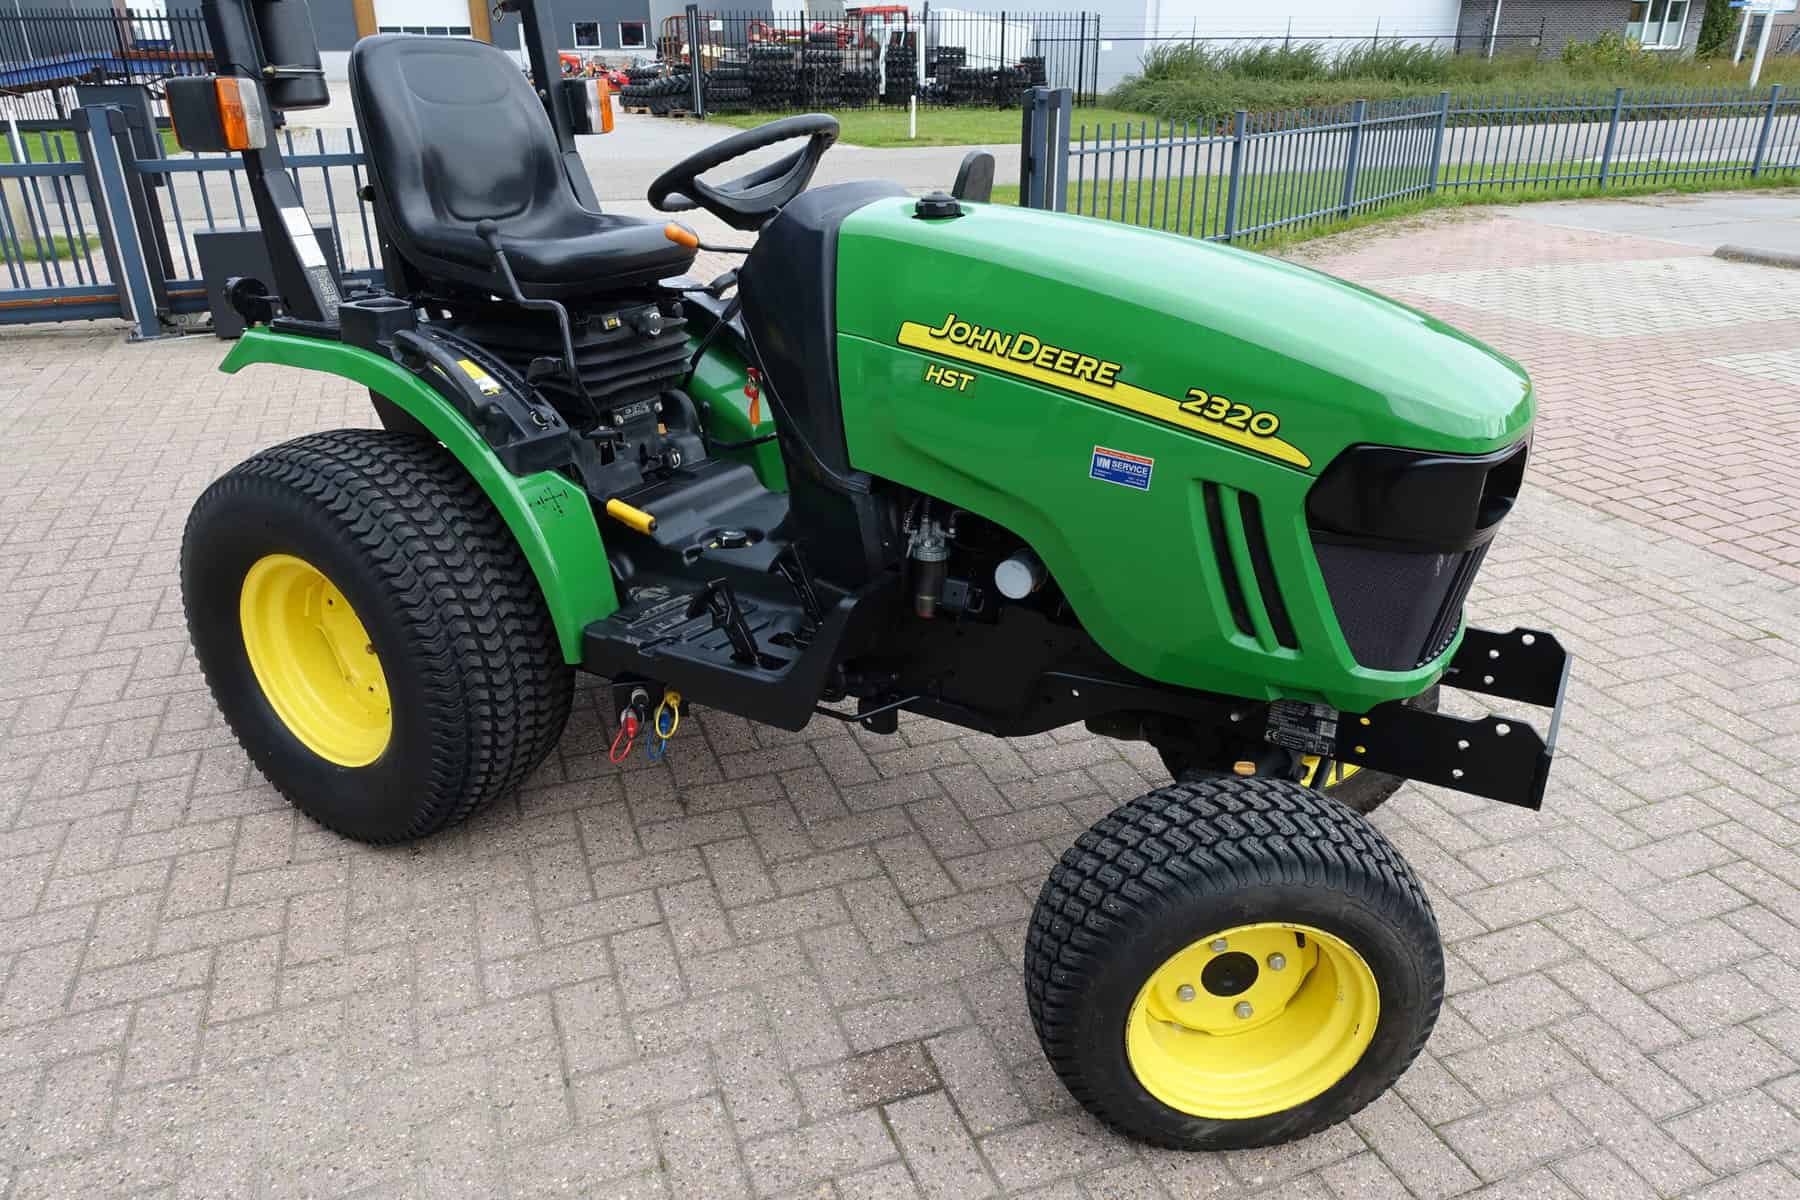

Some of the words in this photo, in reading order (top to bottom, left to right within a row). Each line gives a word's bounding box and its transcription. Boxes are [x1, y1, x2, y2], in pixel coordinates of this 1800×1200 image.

[929, 313, 1012, 357] JOHN
[1008, 333, 1122, 387] DEERE
[925, 364, 975, 392] HST
[1180, 388, 1280, 436] 2320
[1111, 460, 1149, 475] SERVICE
